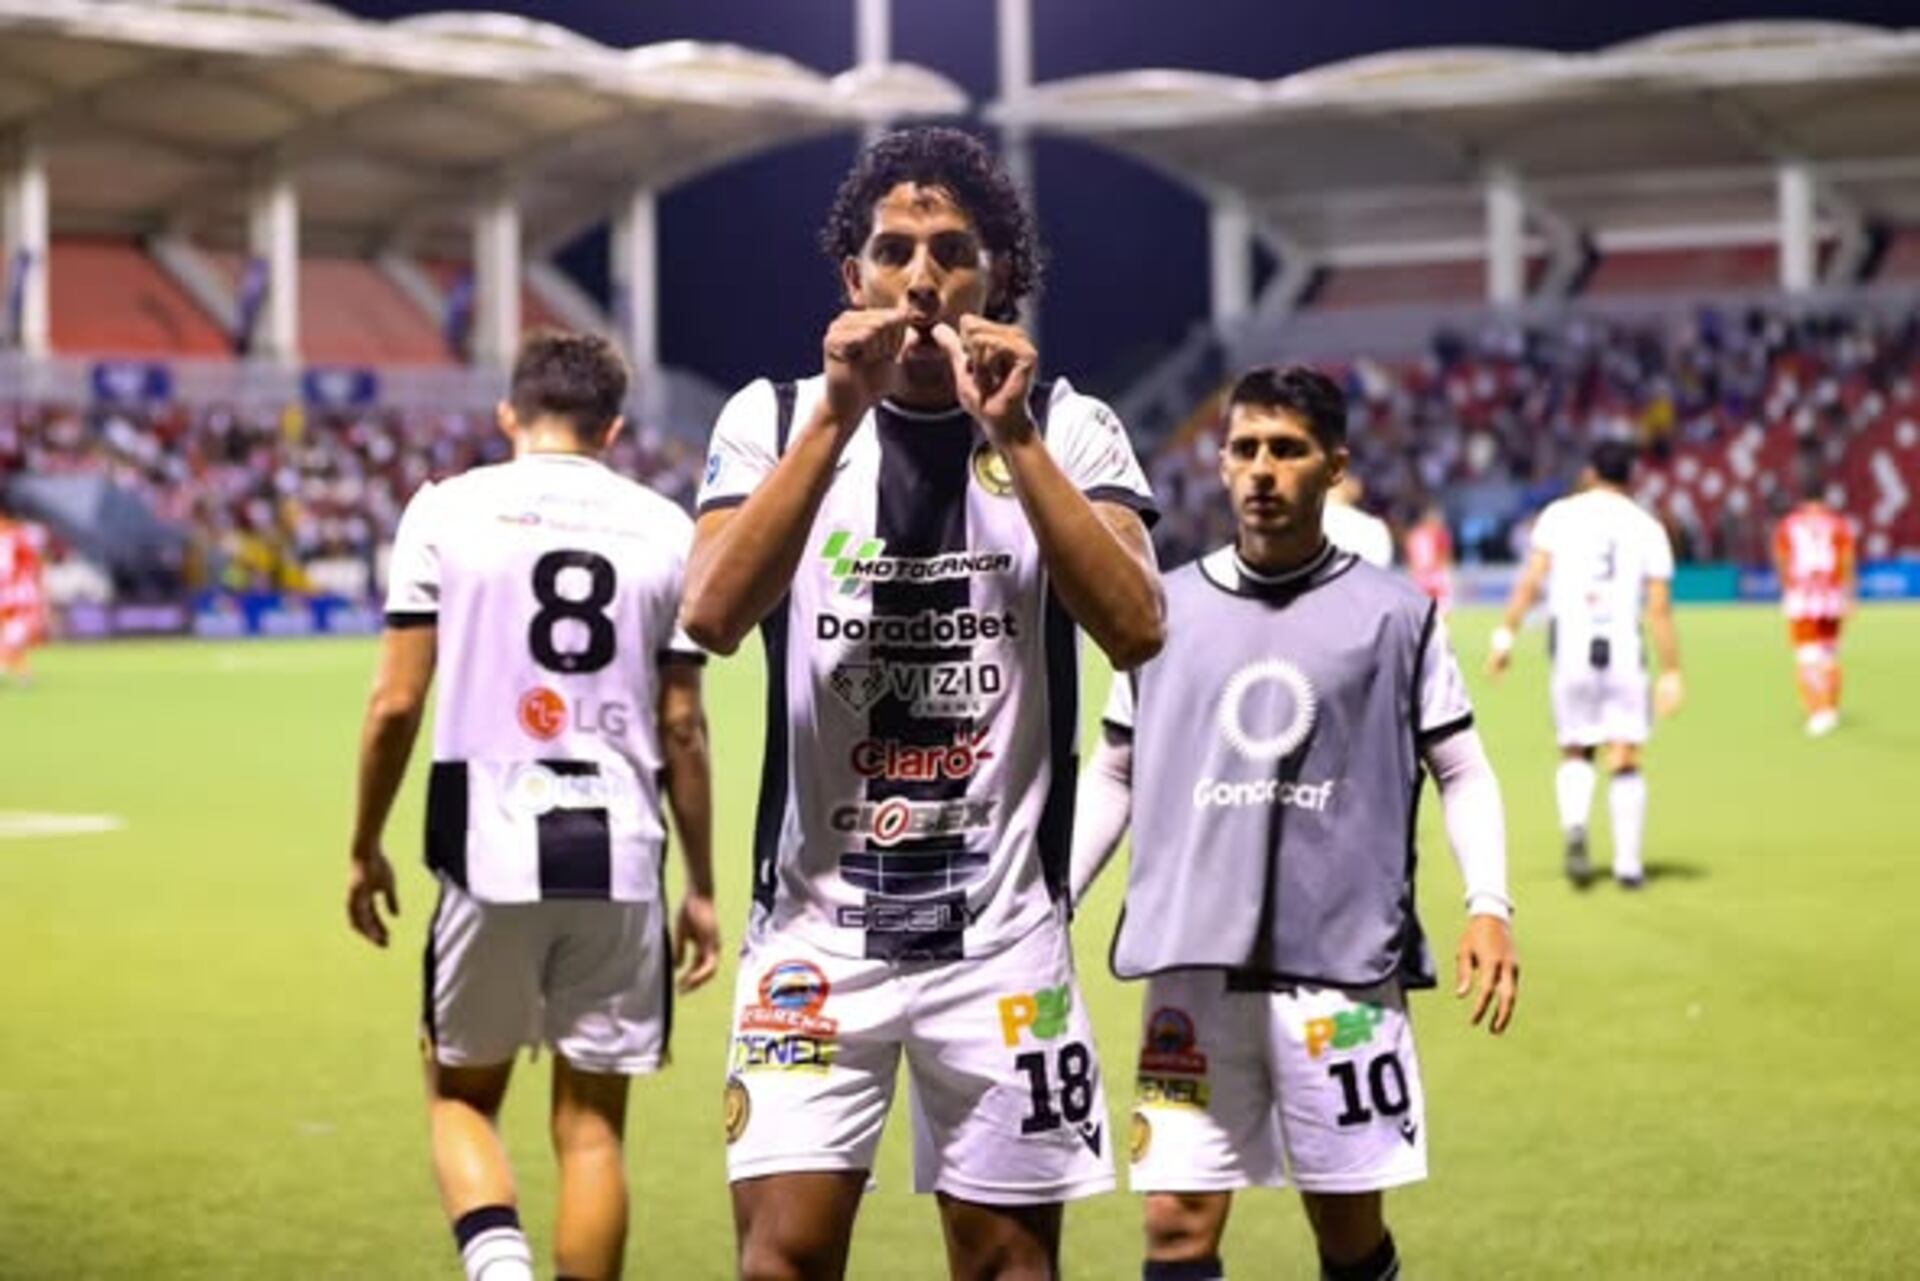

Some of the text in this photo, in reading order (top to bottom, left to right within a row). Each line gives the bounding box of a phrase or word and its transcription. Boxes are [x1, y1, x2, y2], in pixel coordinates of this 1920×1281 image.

[529, 548, 617, 674] 8
[817, 611, 1018, 641] DoradoBet
[892, 664, 1000, 696] VIZIO
[573, 699, 630, 737] LG
[852, 740, 974, 779] Claro
[831, 799, 997, 841] GLOBEX
[837, 904, 987, 931] GEELY
[1015, 1042, 1092, 1135] 18
[1328, 1050, 1411, 1127] 10
